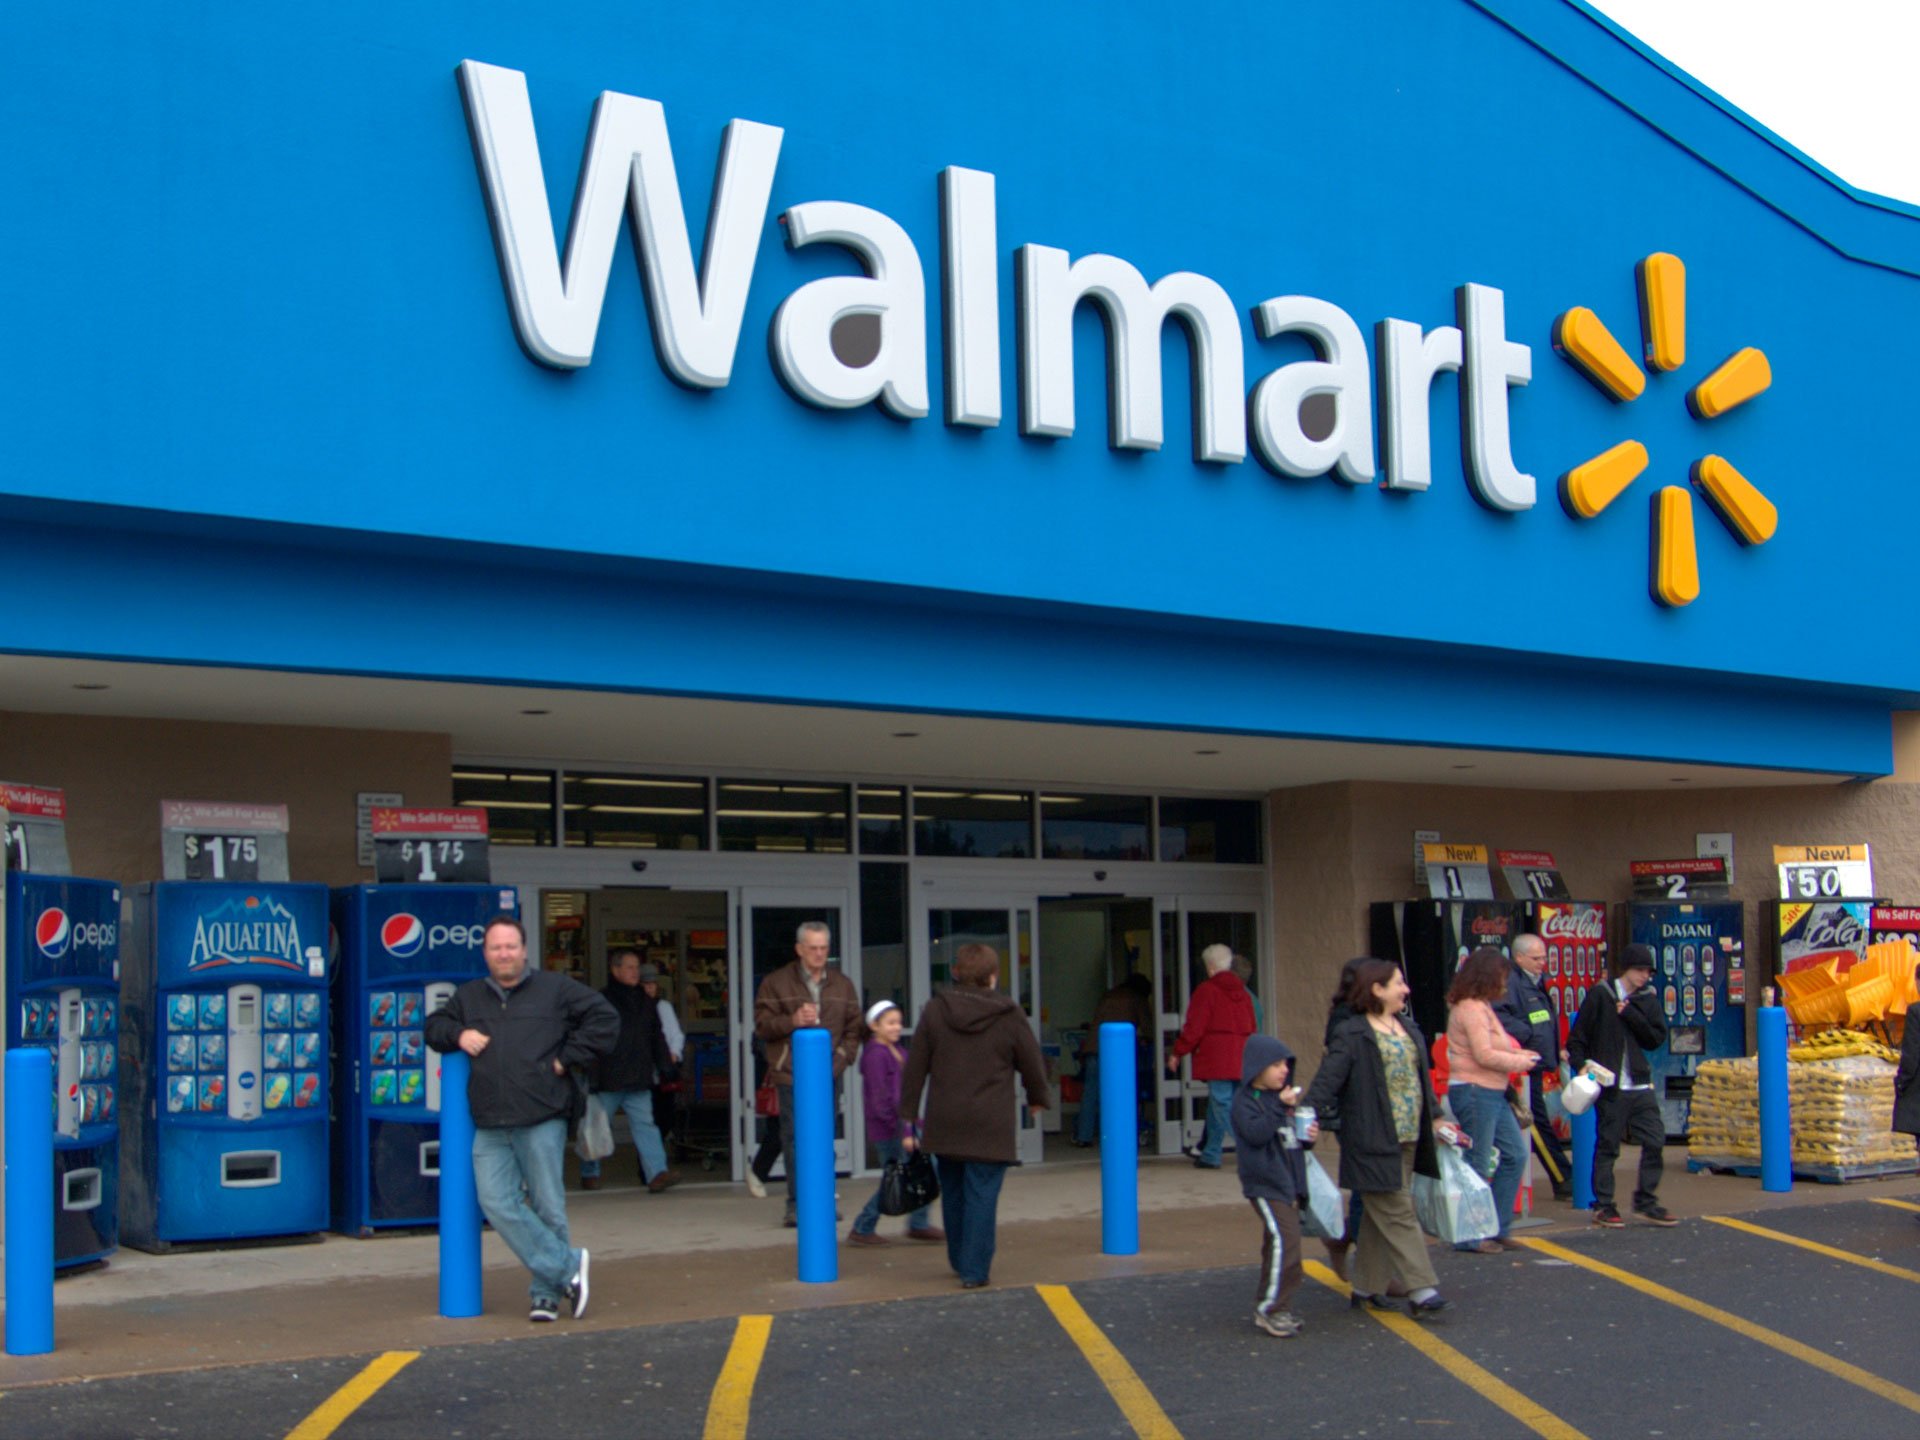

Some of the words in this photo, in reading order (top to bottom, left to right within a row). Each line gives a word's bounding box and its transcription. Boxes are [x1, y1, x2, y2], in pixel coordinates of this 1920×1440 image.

[456, 57, 1538, 514] Walmart
[400, 812, 416, 823] We
[417, 812, 436, 823] Sell
[438, 812, 455, 824] For
[456, 813, 478, 824] Less
[1445, 846, 1478, 861] New!
[1805, 846, 1851, 860] New!
[1447, 868, 1462, 897] 1
[1876, 908, 1891, 920] We
[1892, 908, 1909, 920] Sell
[1910, 909, 1920, 920] Fo
[73, 920, 116, 951] pepsi
[188, 914, 304, 964] AQUAFINA
[429, 925, 485, 950] pep
[1480, 934, 1502, 944] zero
[1662, 923, 1712, 937] DASANI
[1805, 916, 1859, 949] Cola
